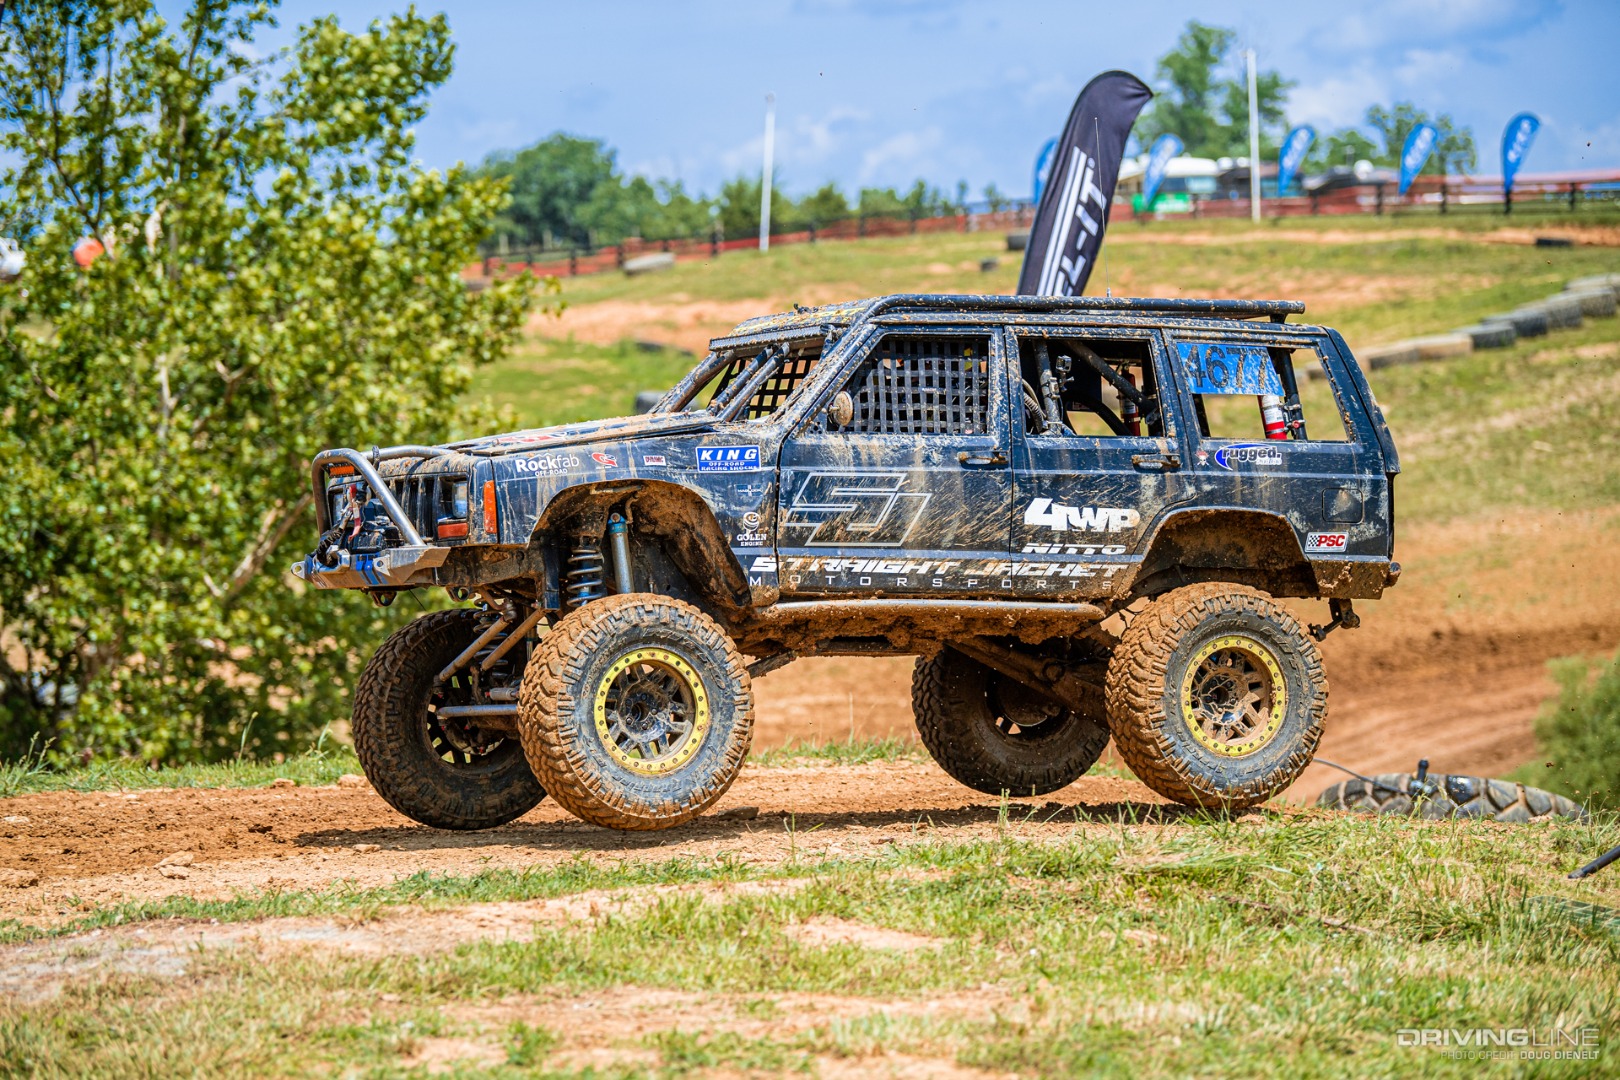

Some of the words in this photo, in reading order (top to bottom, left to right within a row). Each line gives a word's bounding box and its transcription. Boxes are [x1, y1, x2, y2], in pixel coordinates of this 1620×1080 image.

[1184, 344, 1270, 390] 4677
[700, 448, 758, 461] KING
[515, 453, 580, 474] Rockfab
[534, 467, 568, 477] OFF-ROAD
[1024, 497, 1141, 533] 4WP
[736, 533, 767, 542] GOLEN
[1316, 533, 1347, 548] PSC
[1021, 542, 1127, 555] NITTO
[749, 556, 961, 575] STRAIGHT
[963, 559, 1129, 578] JACKET
[749, 576, 1112, 589] MOTORSPORTS
